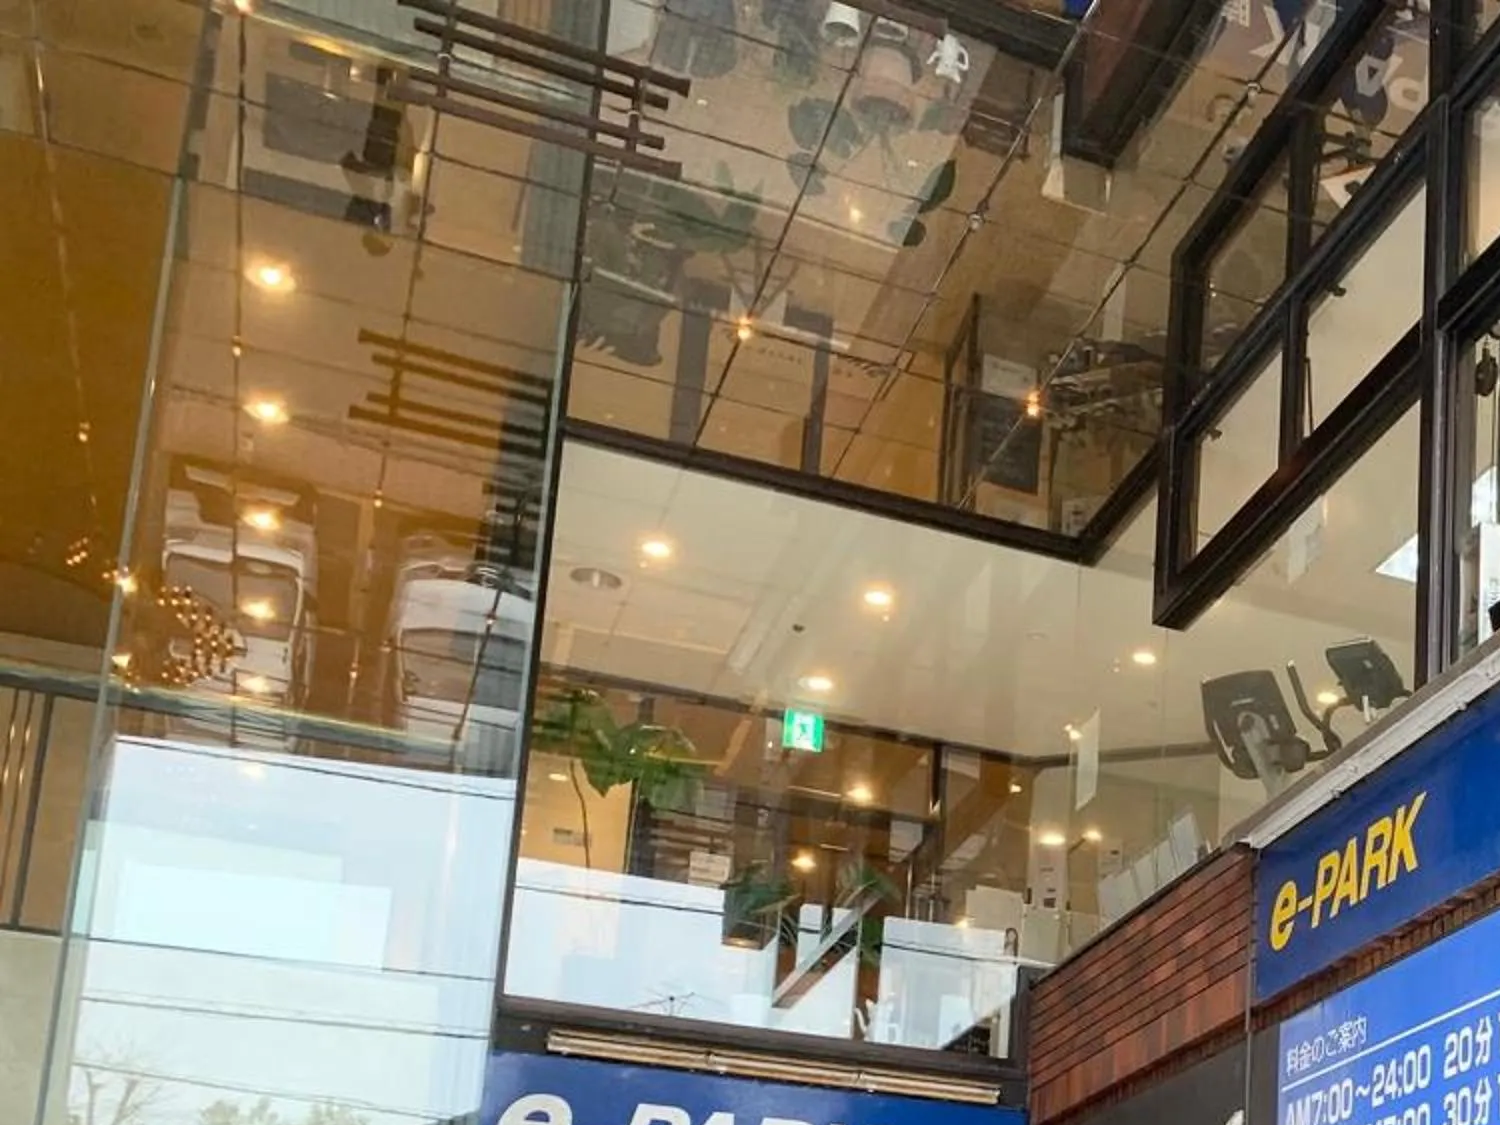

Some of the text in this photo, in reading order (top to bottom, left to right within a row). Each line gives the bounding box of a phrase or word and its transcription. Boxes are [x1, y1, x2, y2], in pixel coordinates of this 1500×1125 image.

[1268, 792, 1427, 952] e-PARK
[1286, 1016, 1368, 1076] 料金のご案内
